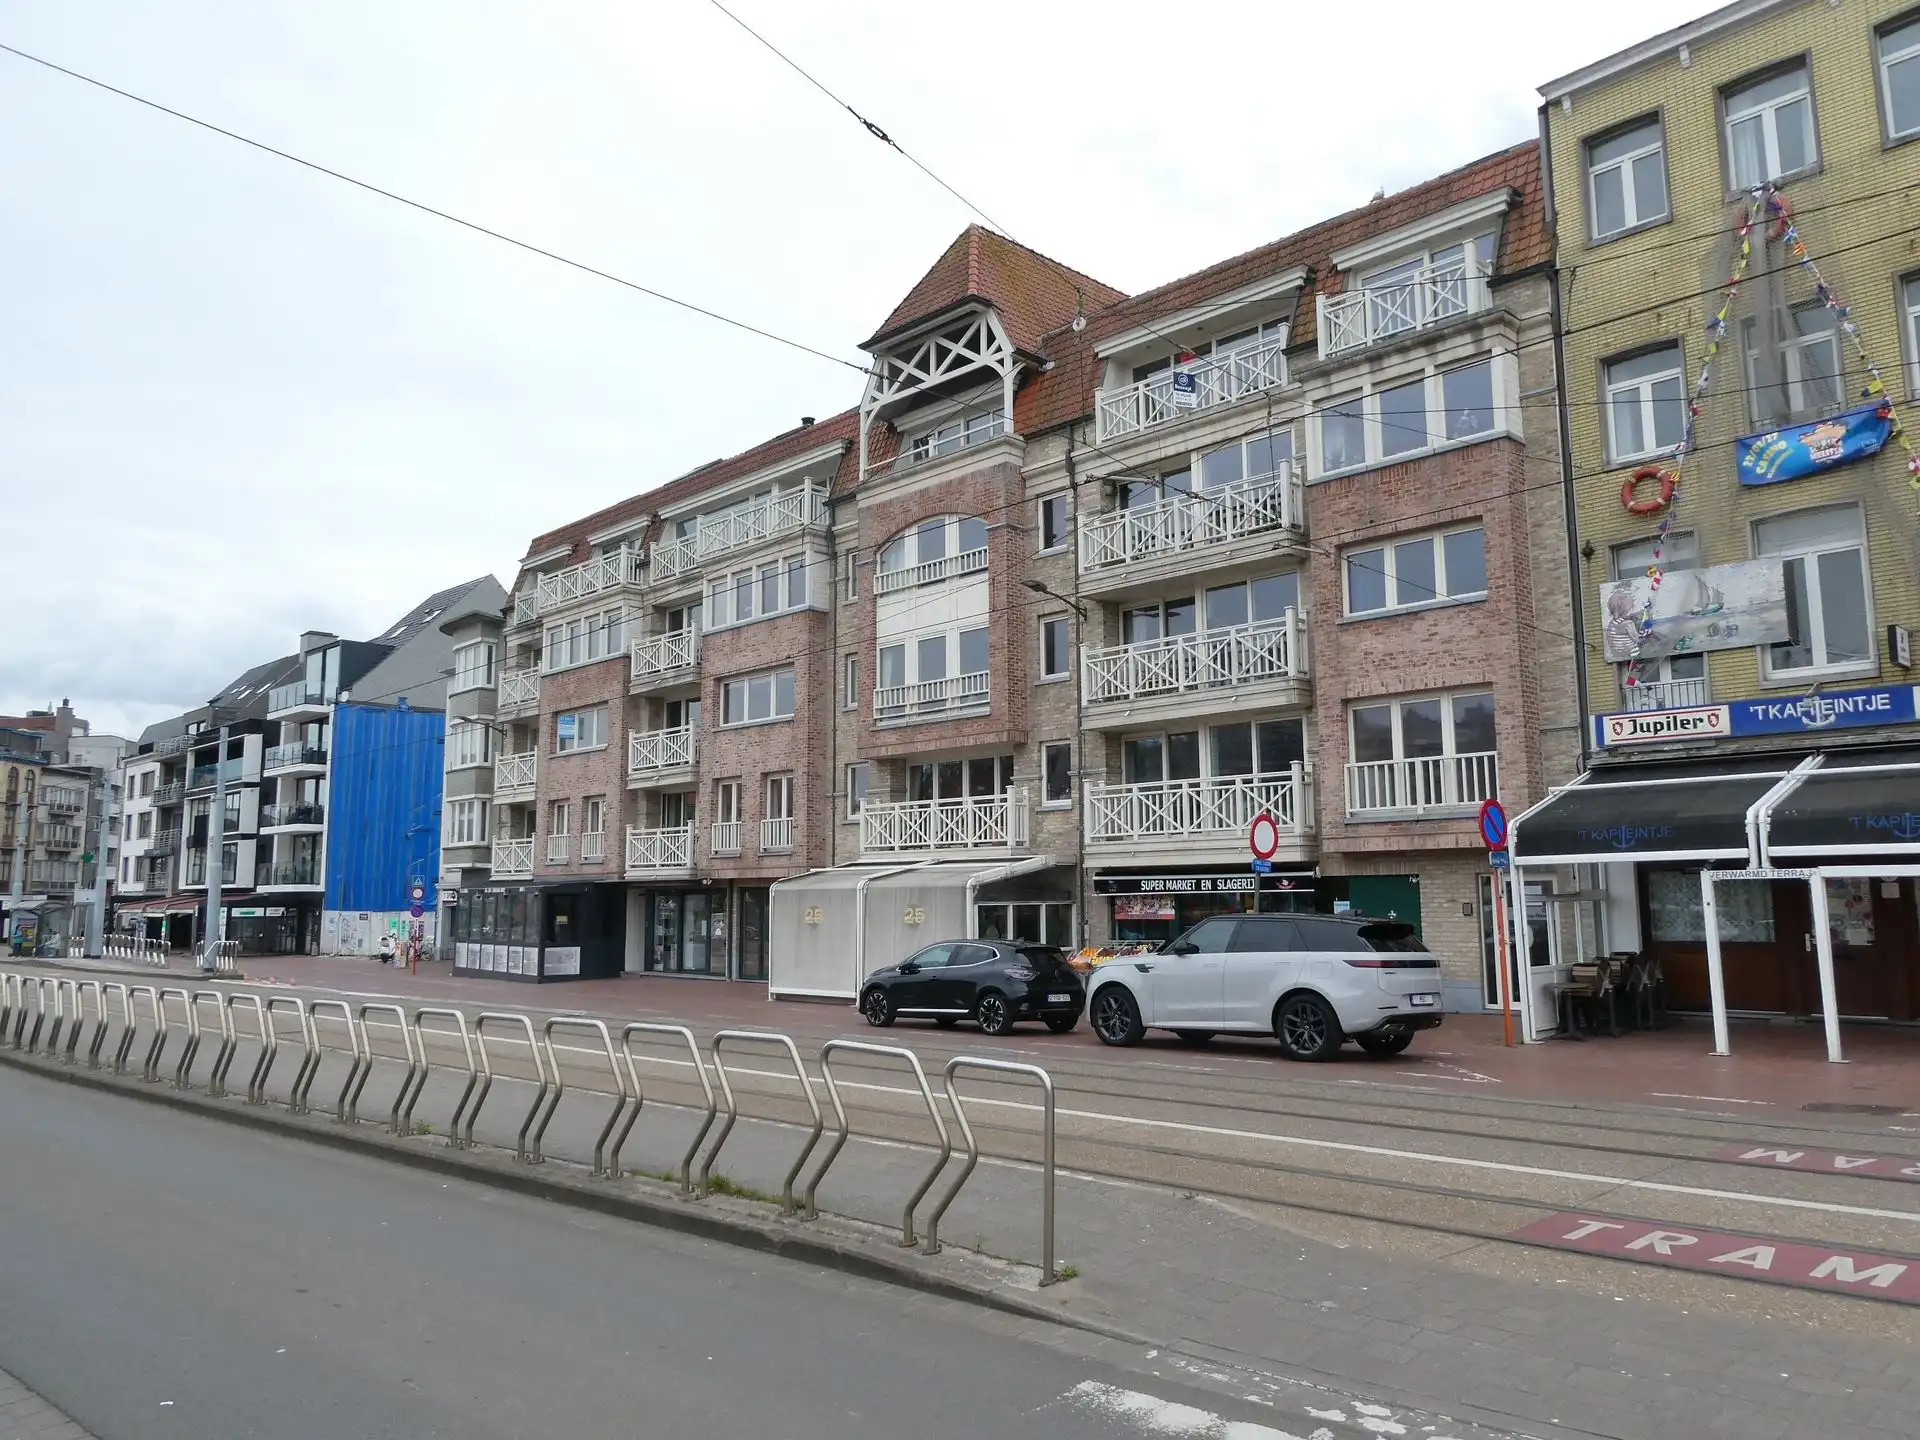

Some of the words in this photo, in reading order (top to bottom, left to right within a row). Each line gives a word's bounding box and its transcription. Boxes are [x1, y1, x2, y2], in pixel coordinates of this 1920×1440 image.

[1627, 715, 1704, 735] Jupiler
[1140, 879, 1165, 891] SUPER
[1166, 879, 1197, 891] MARKET
[1201, 879, 1212, 890] EN
[1561, 1219, 1908, 1288] TRAM
